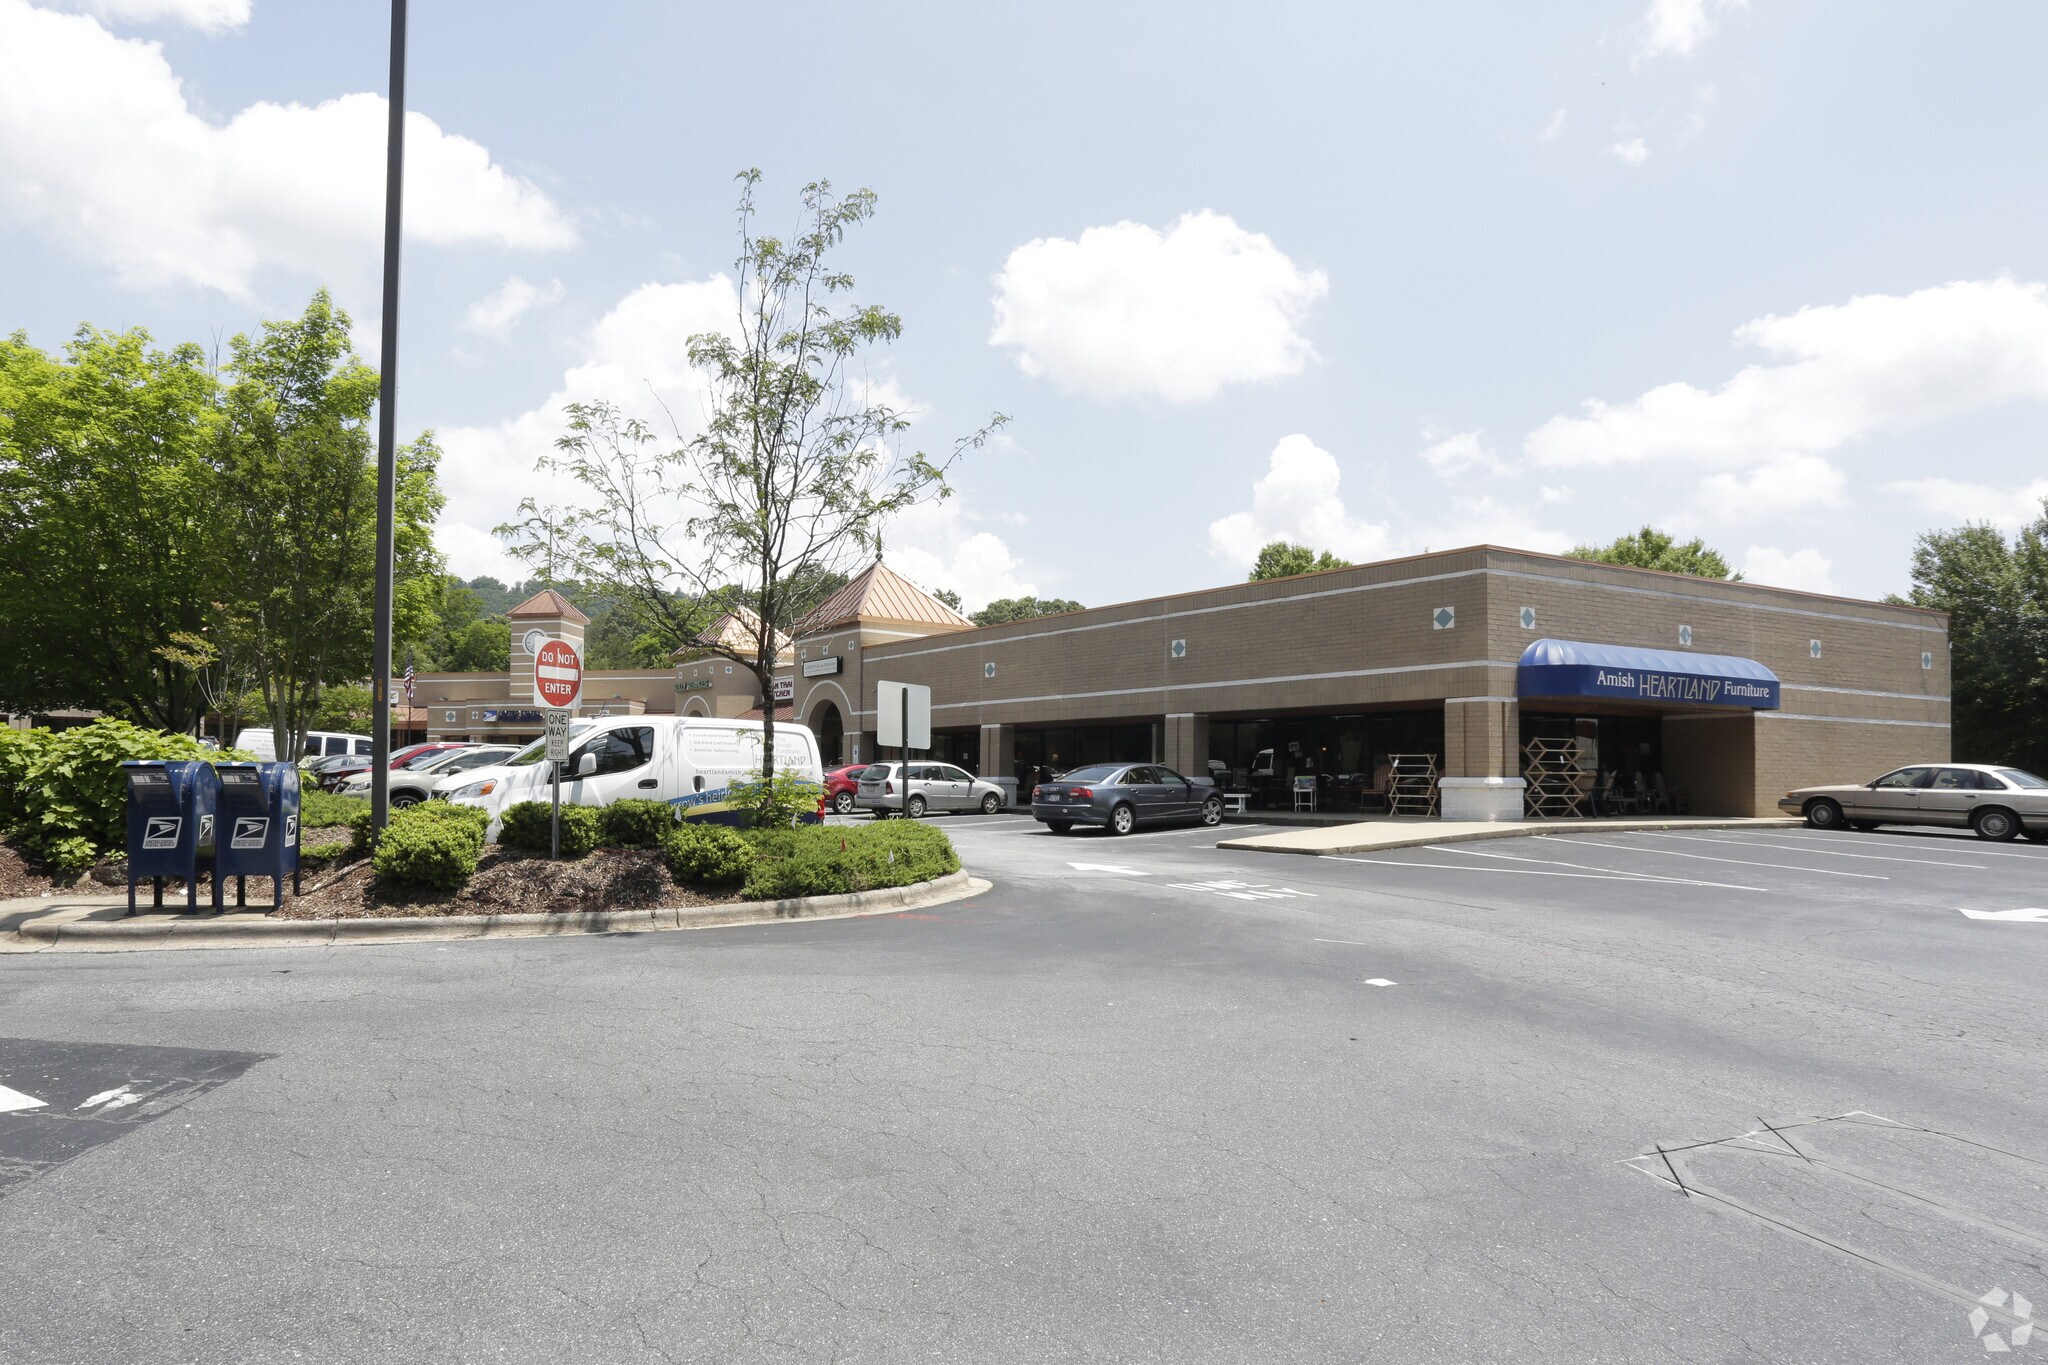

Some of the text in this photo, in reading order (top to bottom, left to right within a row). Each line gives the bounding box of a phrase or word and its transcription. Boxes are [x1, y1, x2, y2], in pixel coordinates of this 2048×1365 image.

[541, 651, 575, 665] DO NOT
[545, 682, 572, 695] ENTER
[1597, 670, 1770, 701] Amish HEARTLAND Furniture
[548, 714, 567, 725] ONE
[548, 727, 567, 738] WAY
[551, 739, 564, 747] KEEP
[550, 748, 564, 757] RIGHT
[755, 754, 806, 766] HRTLAND
[1166, 880, 1271, 892] ONE
[1213, 887, 1319, 901] WAY
